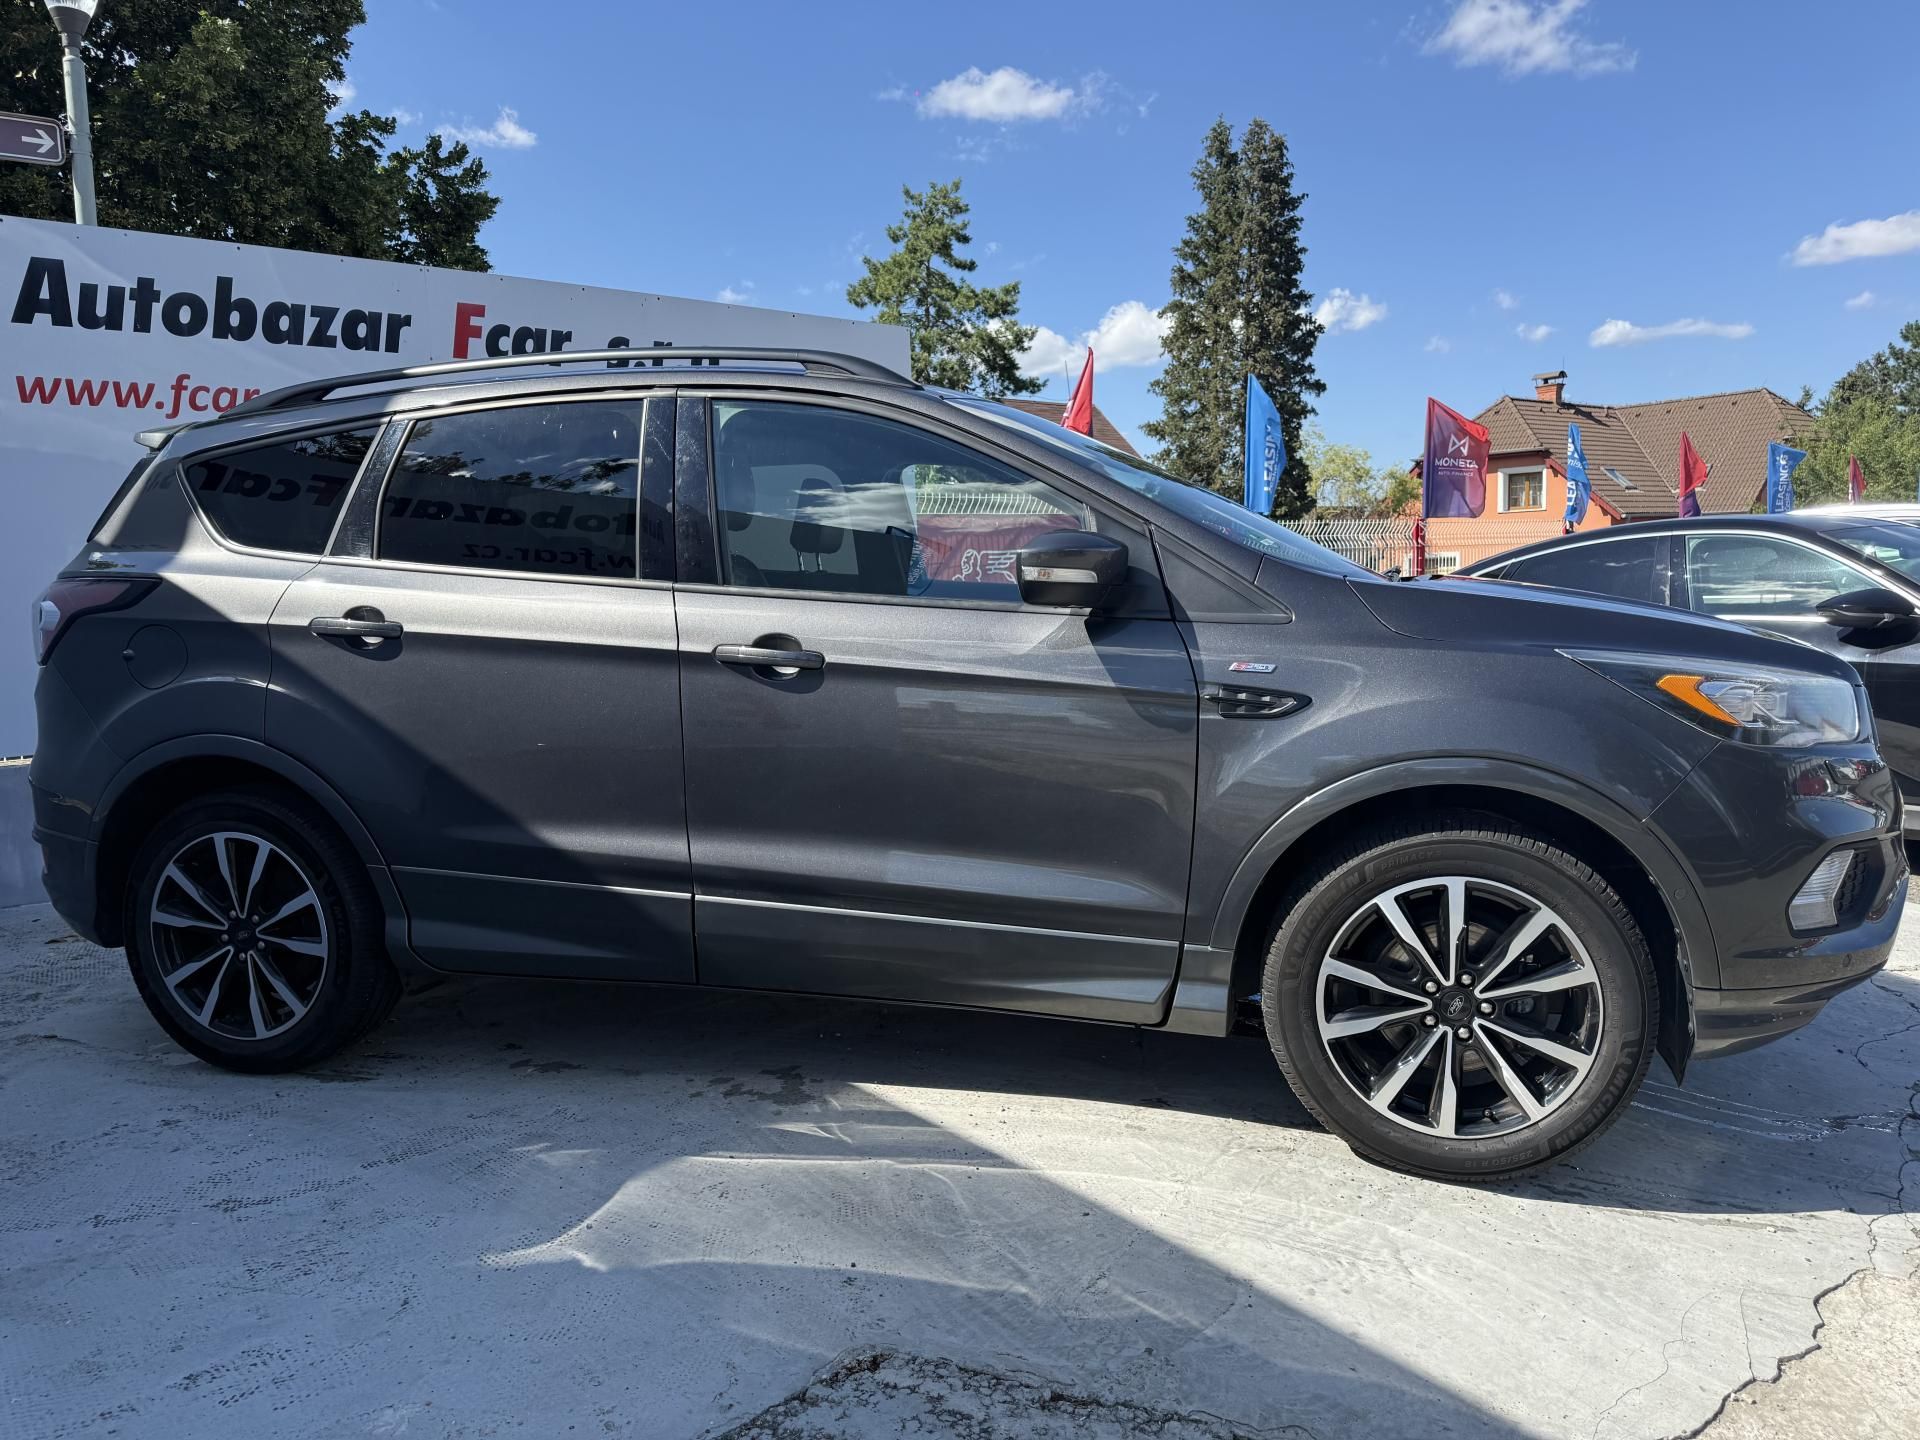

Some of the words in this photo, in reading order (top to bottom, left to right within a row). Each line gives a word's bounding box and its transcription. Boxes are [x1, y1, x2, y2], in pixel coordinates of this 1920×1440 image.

[11, 257, 412, 353] Autobazar
[453, 302, 573, 367] Fcar
[1435, 457, 1478, 468] MONETA
[1774, 465, 1789, 512] LEASING
[1293, 870, 1361, 953] MICHELIN
[1553, 1067, 1628, 1149] MICHELIN
